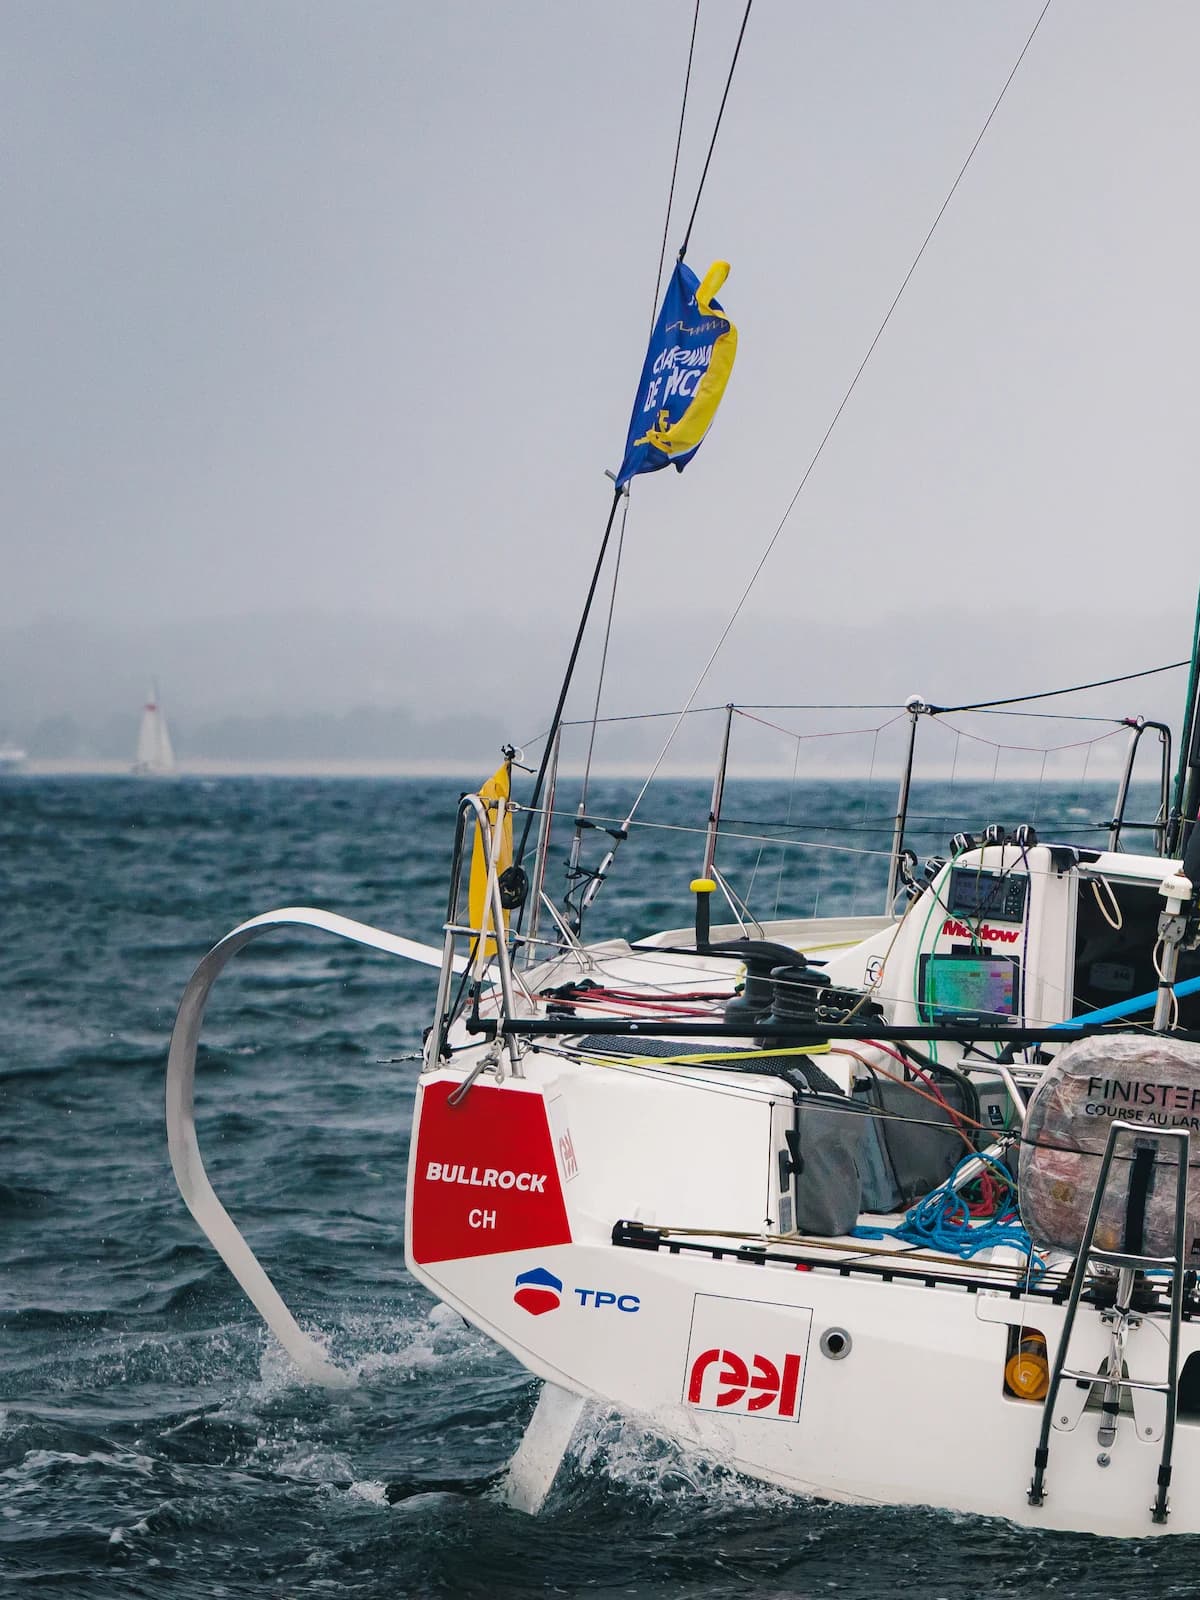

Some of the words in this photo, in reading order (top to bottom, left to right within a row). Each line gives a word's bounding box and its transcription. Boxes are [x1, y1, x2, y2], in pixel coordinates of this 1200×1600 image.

[1085, 1103, 1143, 1122] COURSE
[1147, 1112, 1167, 1126] AU
[425, 1162, 547, 1193] BULLROCK
[468, 1208, 496, 1229] CH
[574, 1288, 641, 1312] TPC
[688, 1349, 801, 1417] reel
